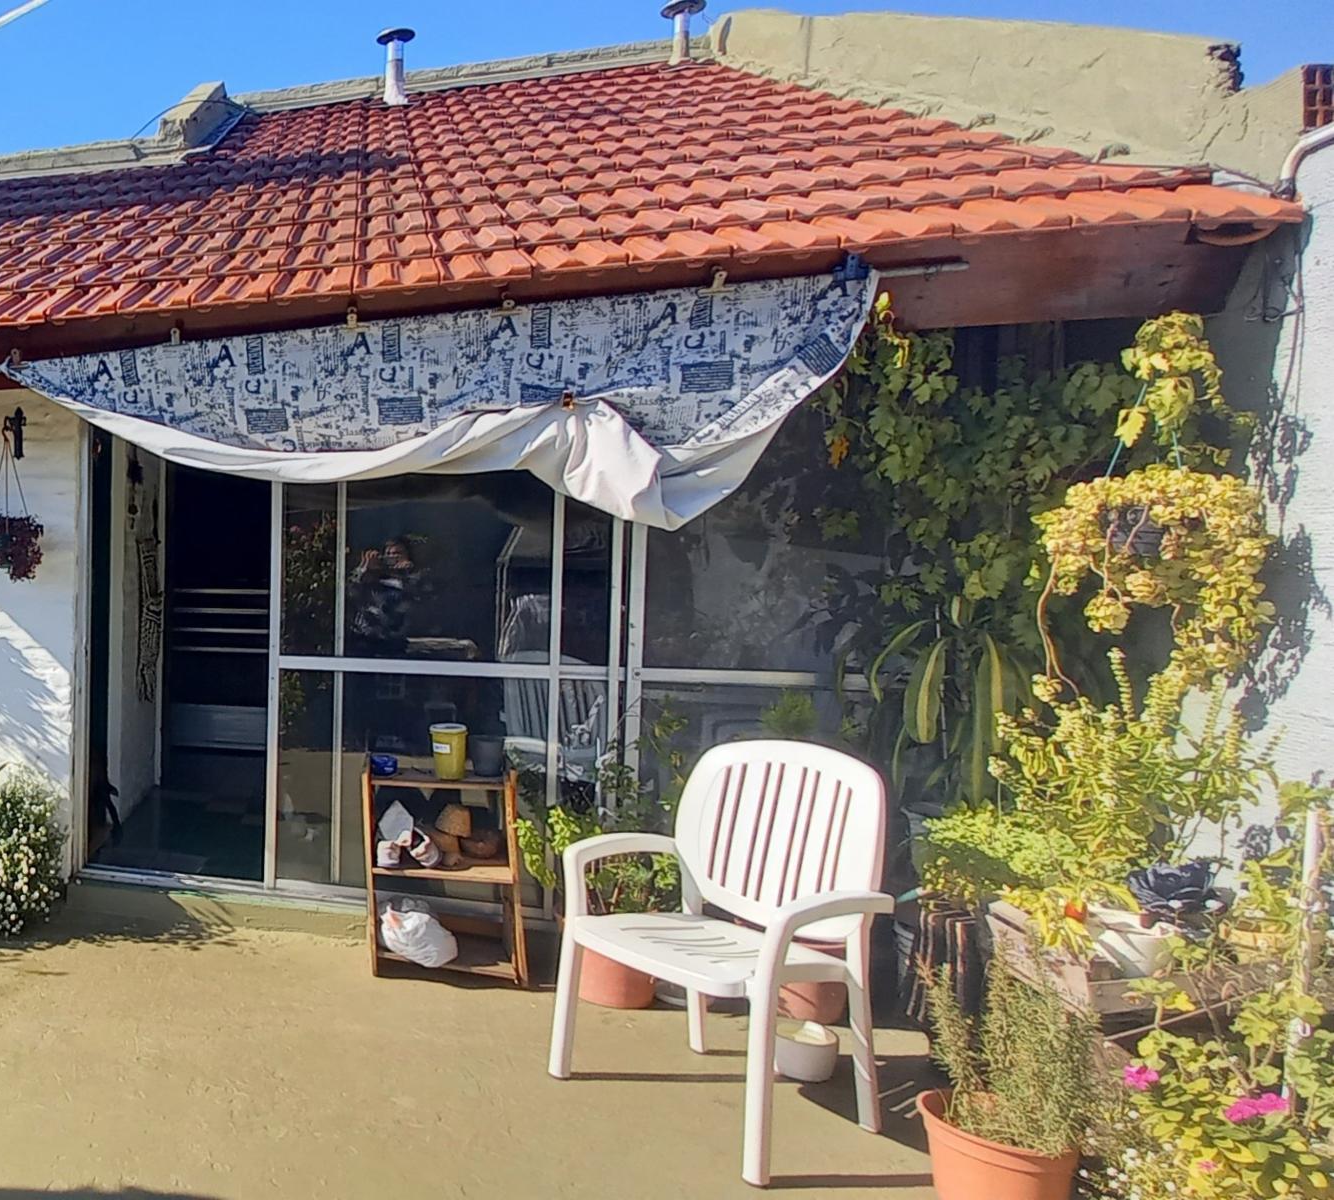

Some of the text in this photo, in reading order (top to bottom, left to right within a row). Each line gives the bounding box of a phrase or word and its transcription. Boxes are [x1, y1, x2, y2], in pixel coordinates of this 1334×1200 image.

[347, 331, 373, 356] A
[213, 344, 237, 368] A
[93, 359, 116, 381] A
